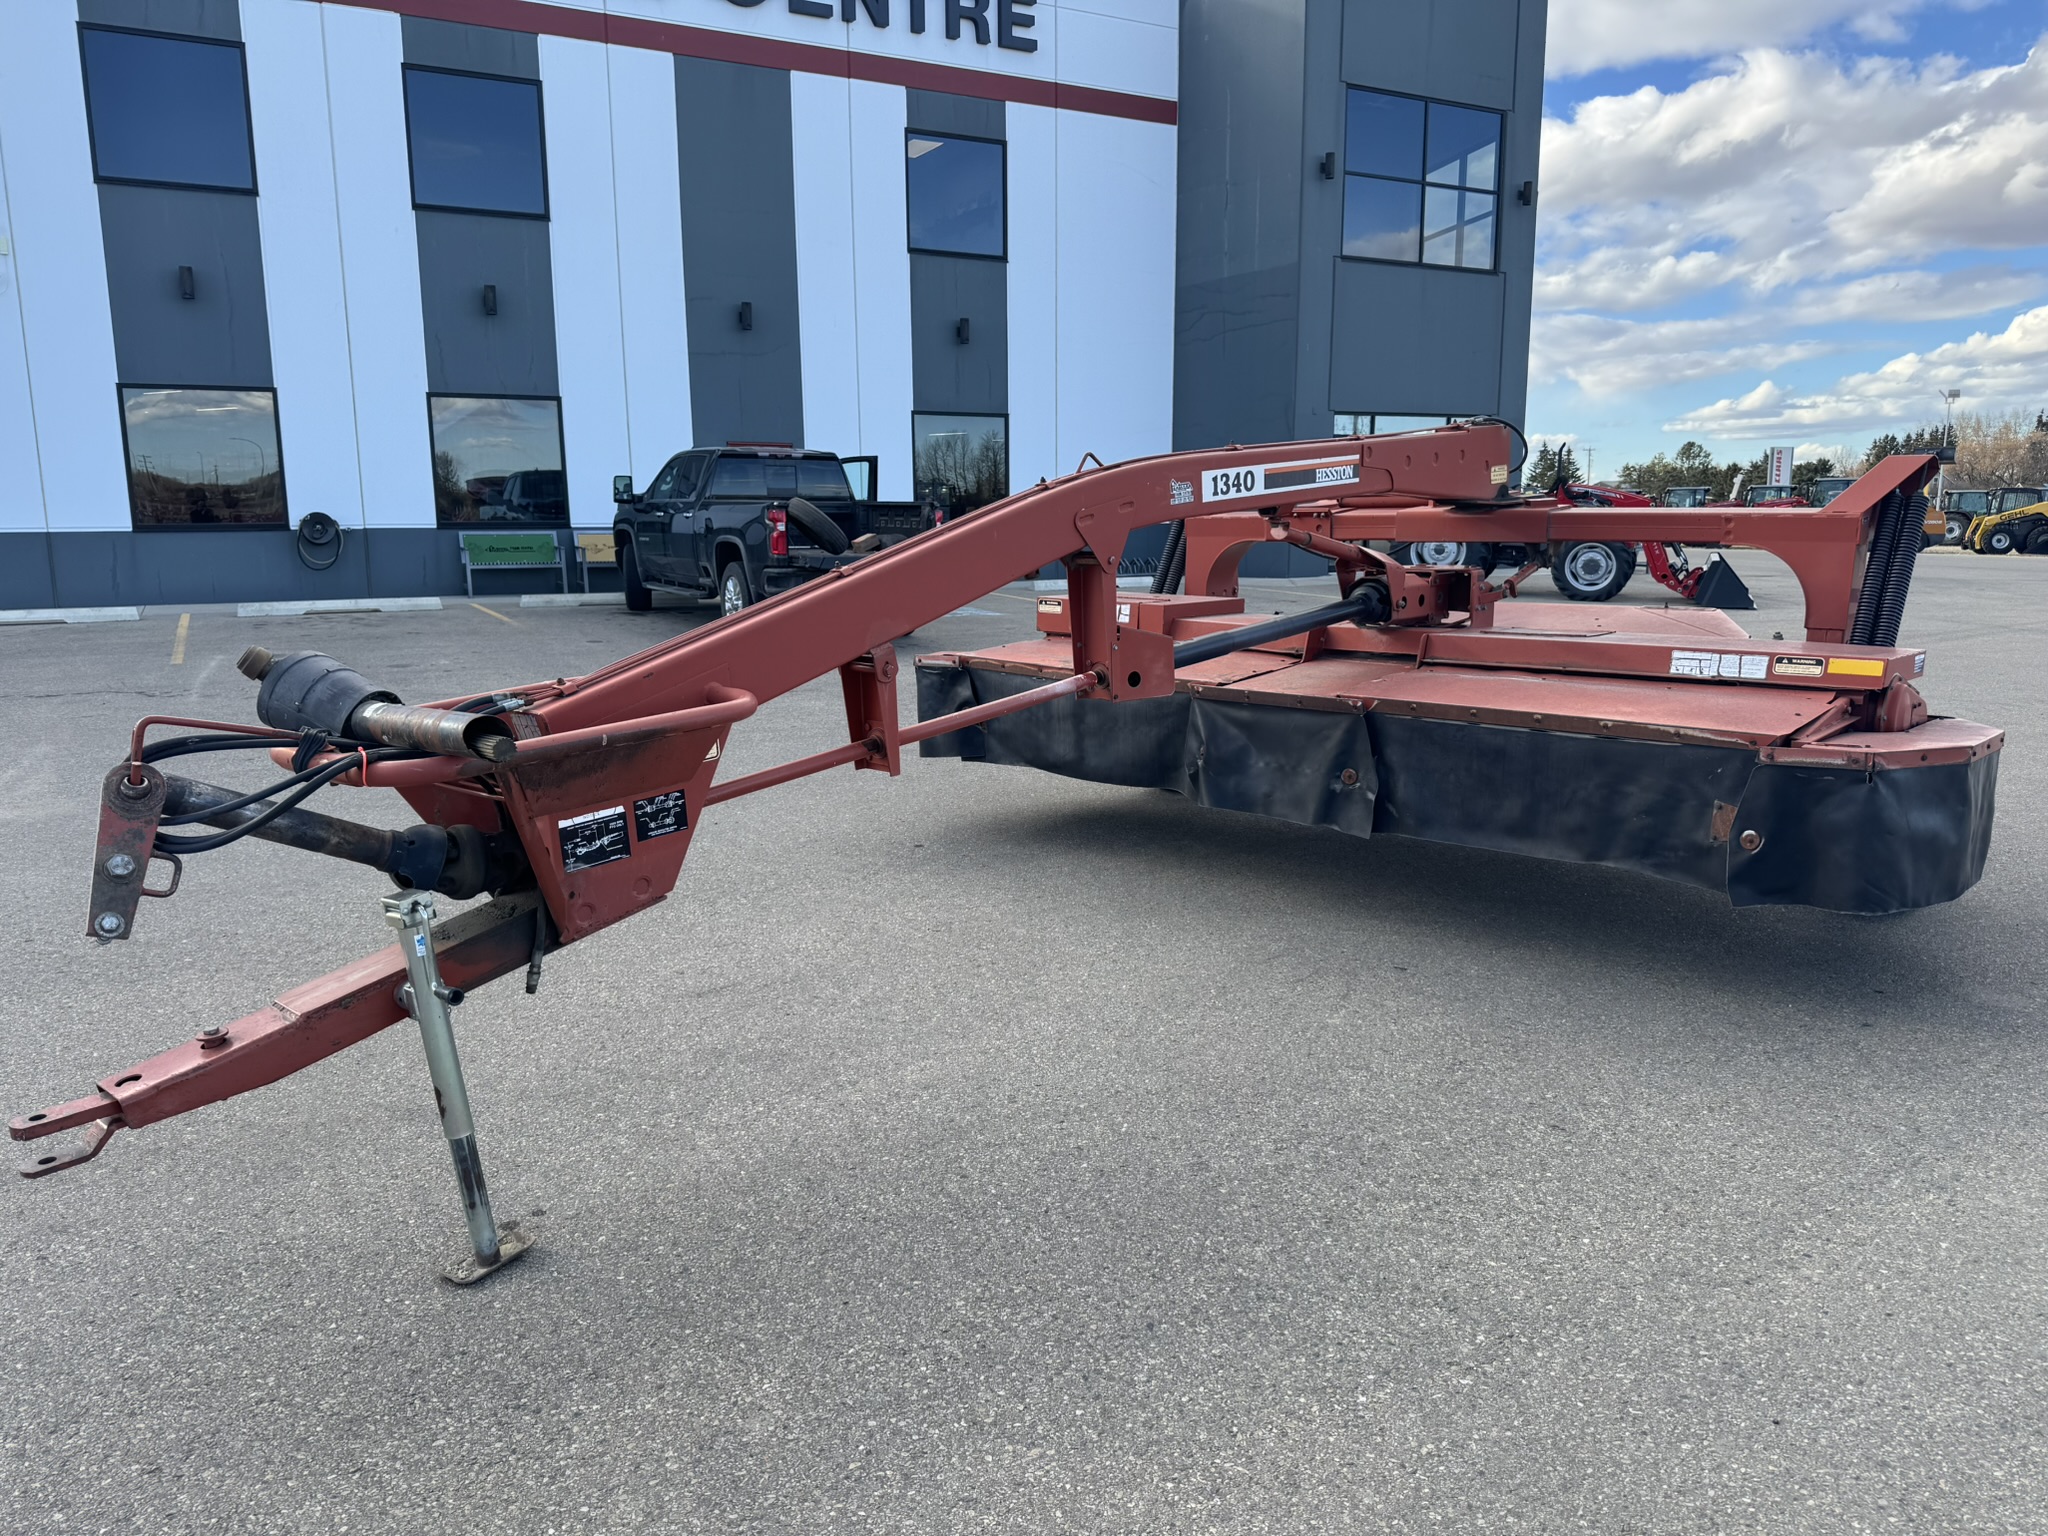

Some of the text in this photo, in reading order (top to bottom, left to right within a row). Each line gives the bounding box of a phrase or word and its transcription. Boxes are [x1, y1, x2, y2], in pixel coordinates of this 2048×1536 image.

[722, 0, 1038, 53] NTRE
[1211, 470, 1256, 497] 1340
[1315, 465, 1354, 483] HESSTON
[1999, 509, 2030, 521] GEHL
